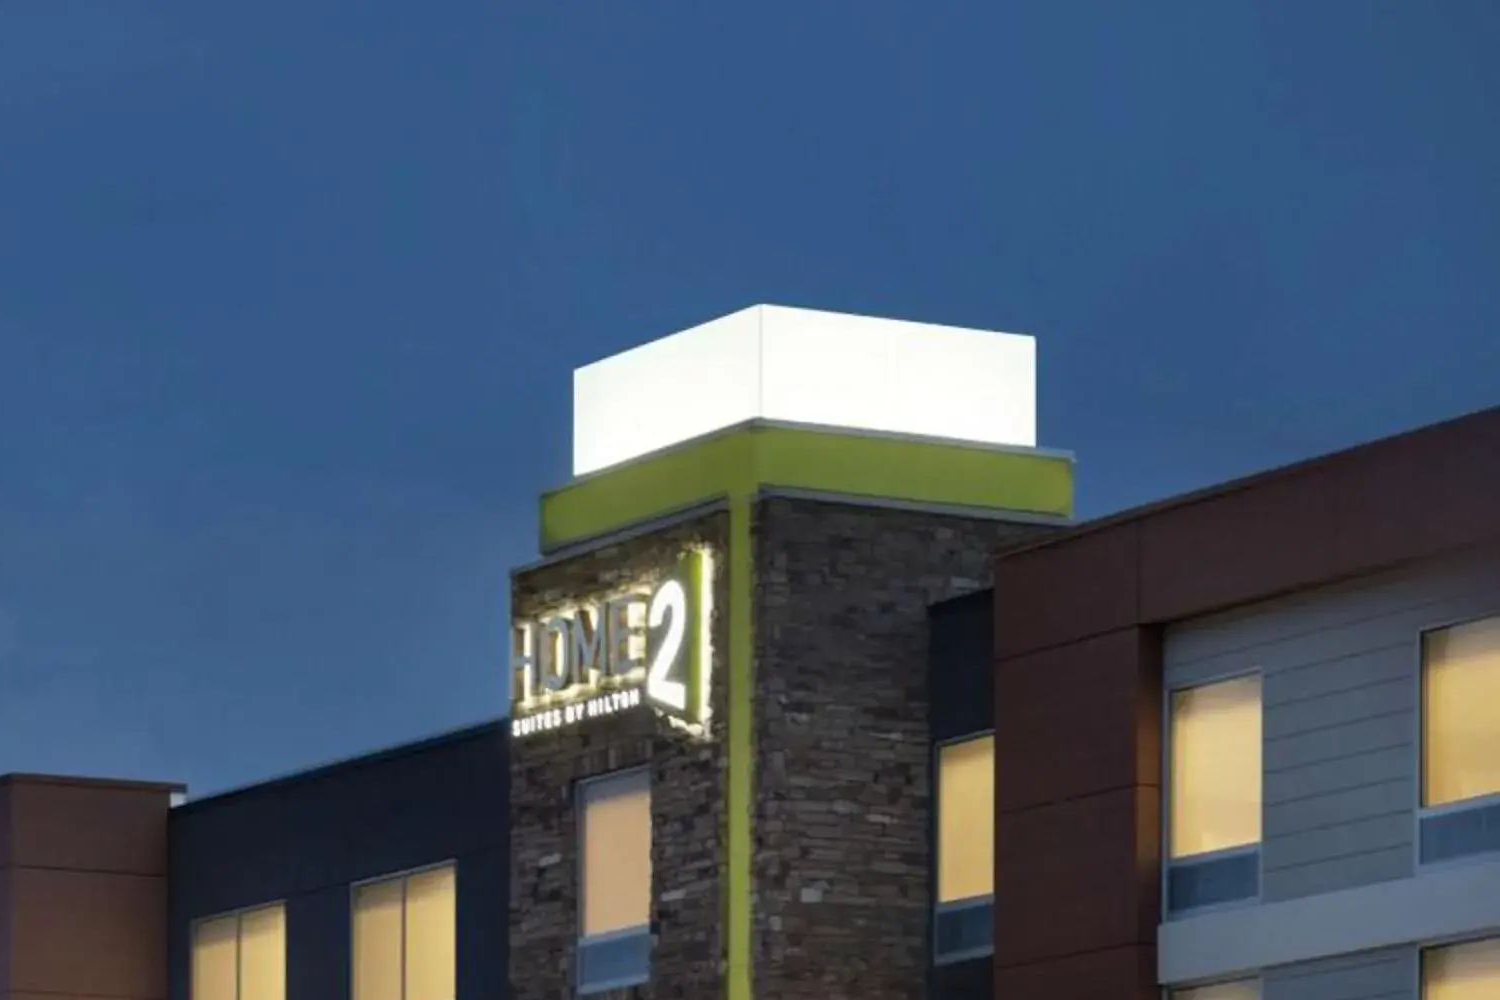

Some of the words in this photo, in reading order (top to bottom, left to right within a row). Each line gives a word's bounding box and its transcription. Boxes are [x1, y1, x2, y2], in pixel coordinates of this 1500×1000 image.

[512, 708, 561, 737] SUITES
[565, 703, 584, 723] BY
[588, 688, 640, 717] HILTON
